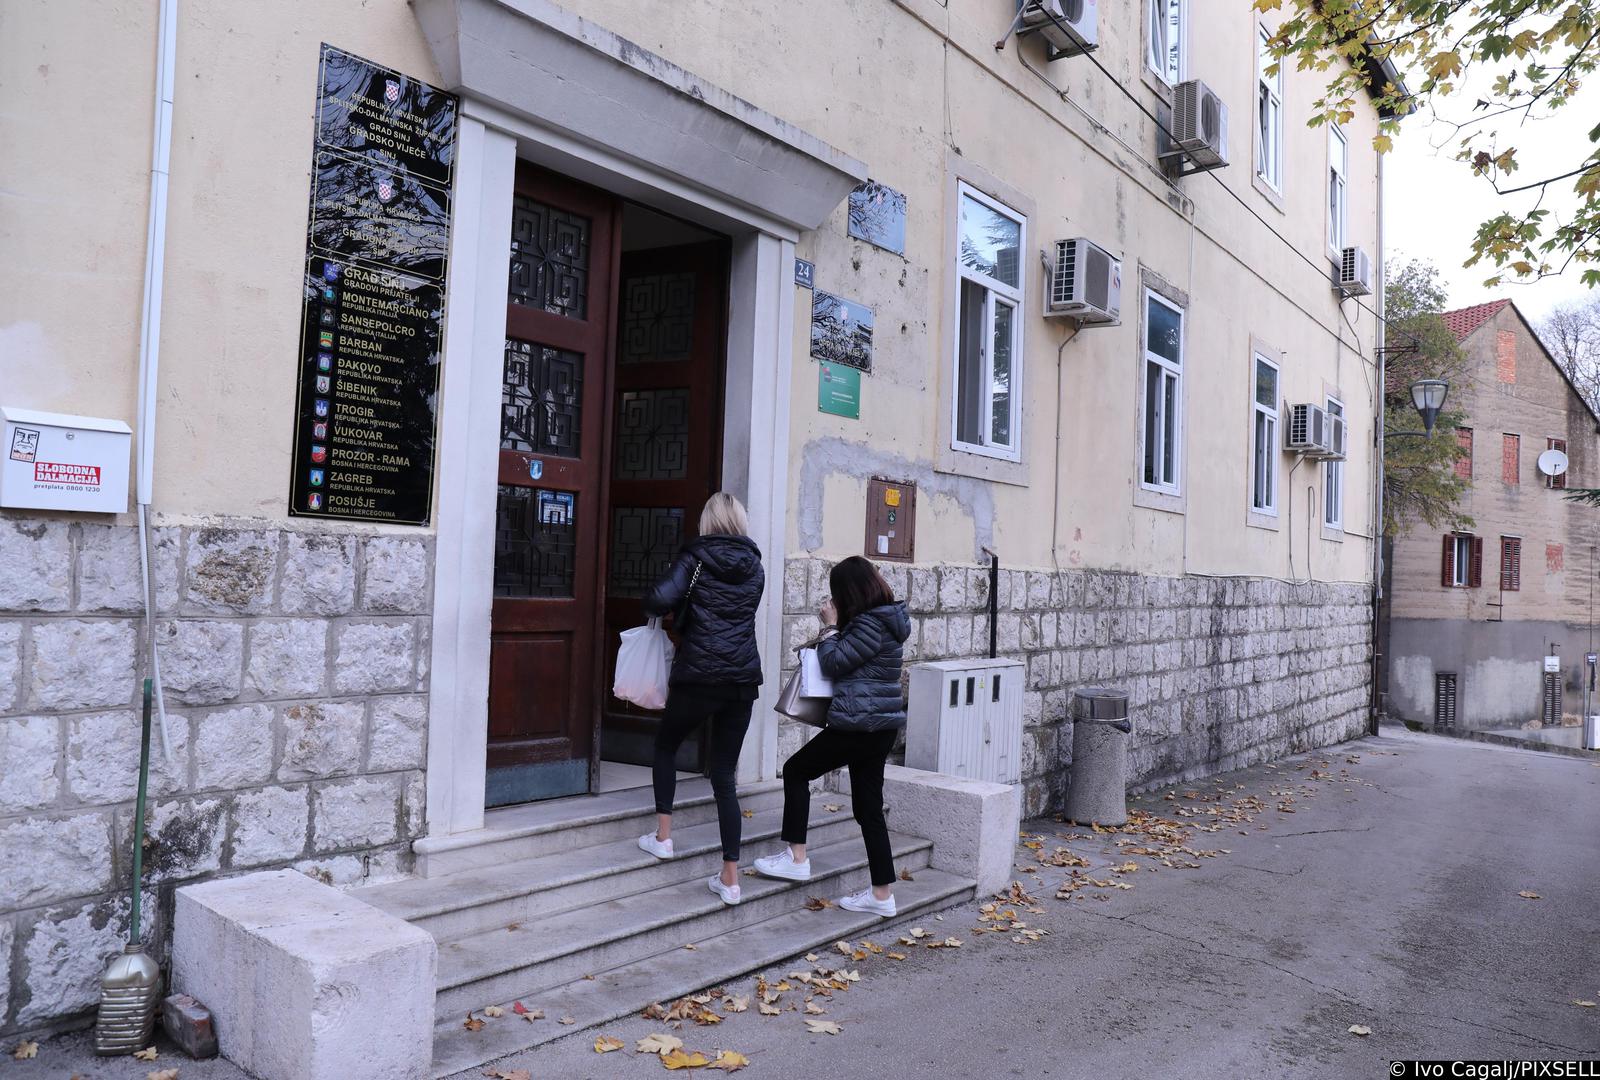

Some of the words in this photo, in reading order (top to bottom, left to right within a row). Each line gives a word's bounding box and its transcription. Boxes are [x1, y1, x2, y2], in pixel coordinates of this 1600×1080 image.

[329, 96, 413, 132] SPLITSKO-DALMATINSKA
[352, 92, 390, 112] REPUBLIKA
[394, 109, 428, 128] HRVATSKA
[369, 122, 392, 136] GRAD
[394, 131, 411, 142] SINJ
[349, 126, 394, 148] GRADSKO
[396, 143, 426, 160] VIJEĆE
[380, 149, 397, 160] SINJ
[362, 224, 386, 235] GRAD
[344, 267, 380, 284] GRAD
[381, 276, 405, 290] SINJ
[798, 263, 809, 278] 24
[343, 278, 378, 293] GRADOVI
[380, 288, 420, 302] PRIJATELJI
[342, 292, 429, 319] MONTEMARCIANO
[342, 302, 376, 314] REPUBLIKA
[377, 309, 398, 319] ITALIJA
[340, 324, 374, 336] REPUBLIKA
[376, 331, 397, 341] ITALIJA
[341, 313, 416, 337] SANSEPOLCRO
[340, 336, 382, 353] BARBAN
[339, 347, 373, 358] REPUBLIKA
[374, 354, 404, 364] HRVATSKA
[338, 358, 382, 374] ĐAKOVO
[338, 369, 372, 380] REPUBLIKA
[372, 375, 403, 385] HRVATSKA
[336, 379, 378, 396] ŠIBENIK
[336, 391, 370, 402] REPUBLIKA
[371, 397, 401, 407] HRVATSKA
[336, 403, 374, 416] TROGIR
[335, 414, 369, 424] REPUBLIKA
[370, 419, 400, 428] HRVATSKA
[334, 426, 383, 441] VUKOVAR
[333, 437, 367, 447] REPUBLIKA
[368, 441, 398, 450] HRVATSKA
[332, 448, 374, 462] PROZOR
[382, 454, 410, 467] RAMA
[37, 464, 96, 475] SLOBODNA
[357, 462, 399, 472] HERCEGOVINA
[37, 472, 98, 484] DALMACIJA
[330, 472, 373, 485] ZAGREB
[330, 484, 364, 492] REPUBLIKA
[365, 487, 396, 495] HRVATSKA
[328, 495, 376, 508] POSUŠJE
[354, 508, 396, 518] HERCEGOVINA
